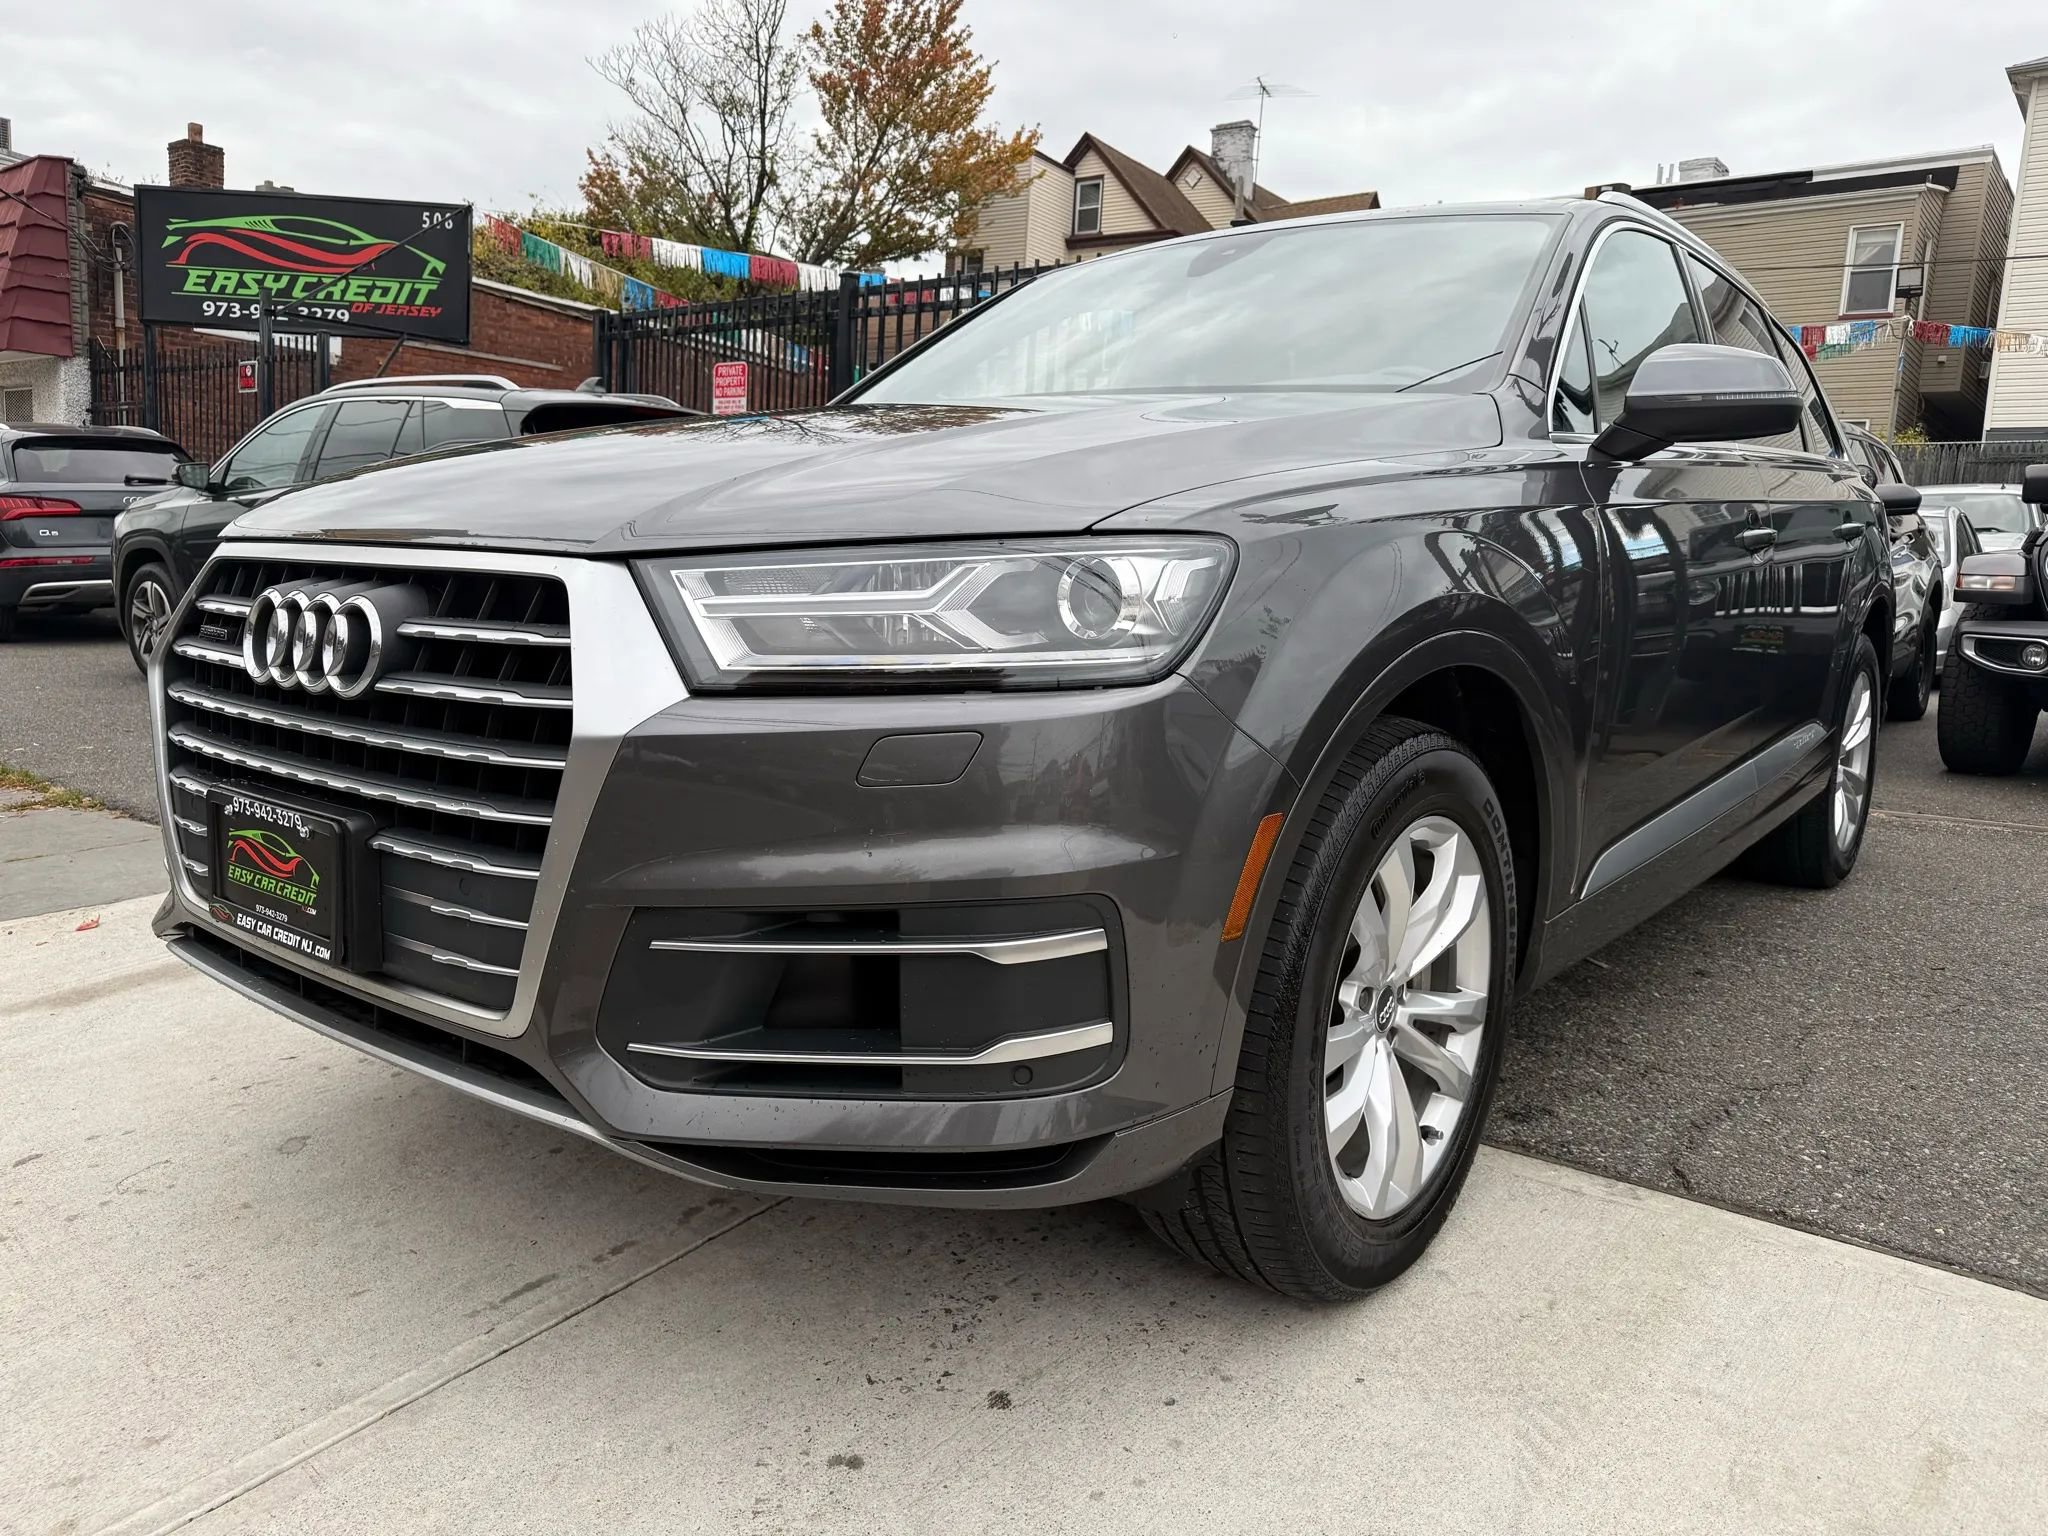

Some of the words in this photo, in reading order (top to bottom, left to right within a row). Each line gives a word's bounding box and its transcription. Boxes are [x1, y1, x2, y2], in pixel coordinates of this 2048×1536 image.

[183, 269, 290, 296] EASY
[292, 276, 439, 305] CREDIT
[351, 302, 375, 313] OF
[376, 304, 443, 317] JERSEY
[718, 365, 744, 376] PRIVATE
[715, 377, 745, 386] PROPERTY
[715, 387, 722, 396] NO
[232, 797, 303, 830] 973-942-3279
[228, 865, 254, 884] EASY
[253, 874, 276, 893] CAR
[276, 882, 317, 906] CREDIT
[255, 904, 288, 922] 973-942-3279
[236, 913, 256, 930] EASY
[256, 921, 273, 937] CAR
[272, 927, 301, 948] CREDIT
